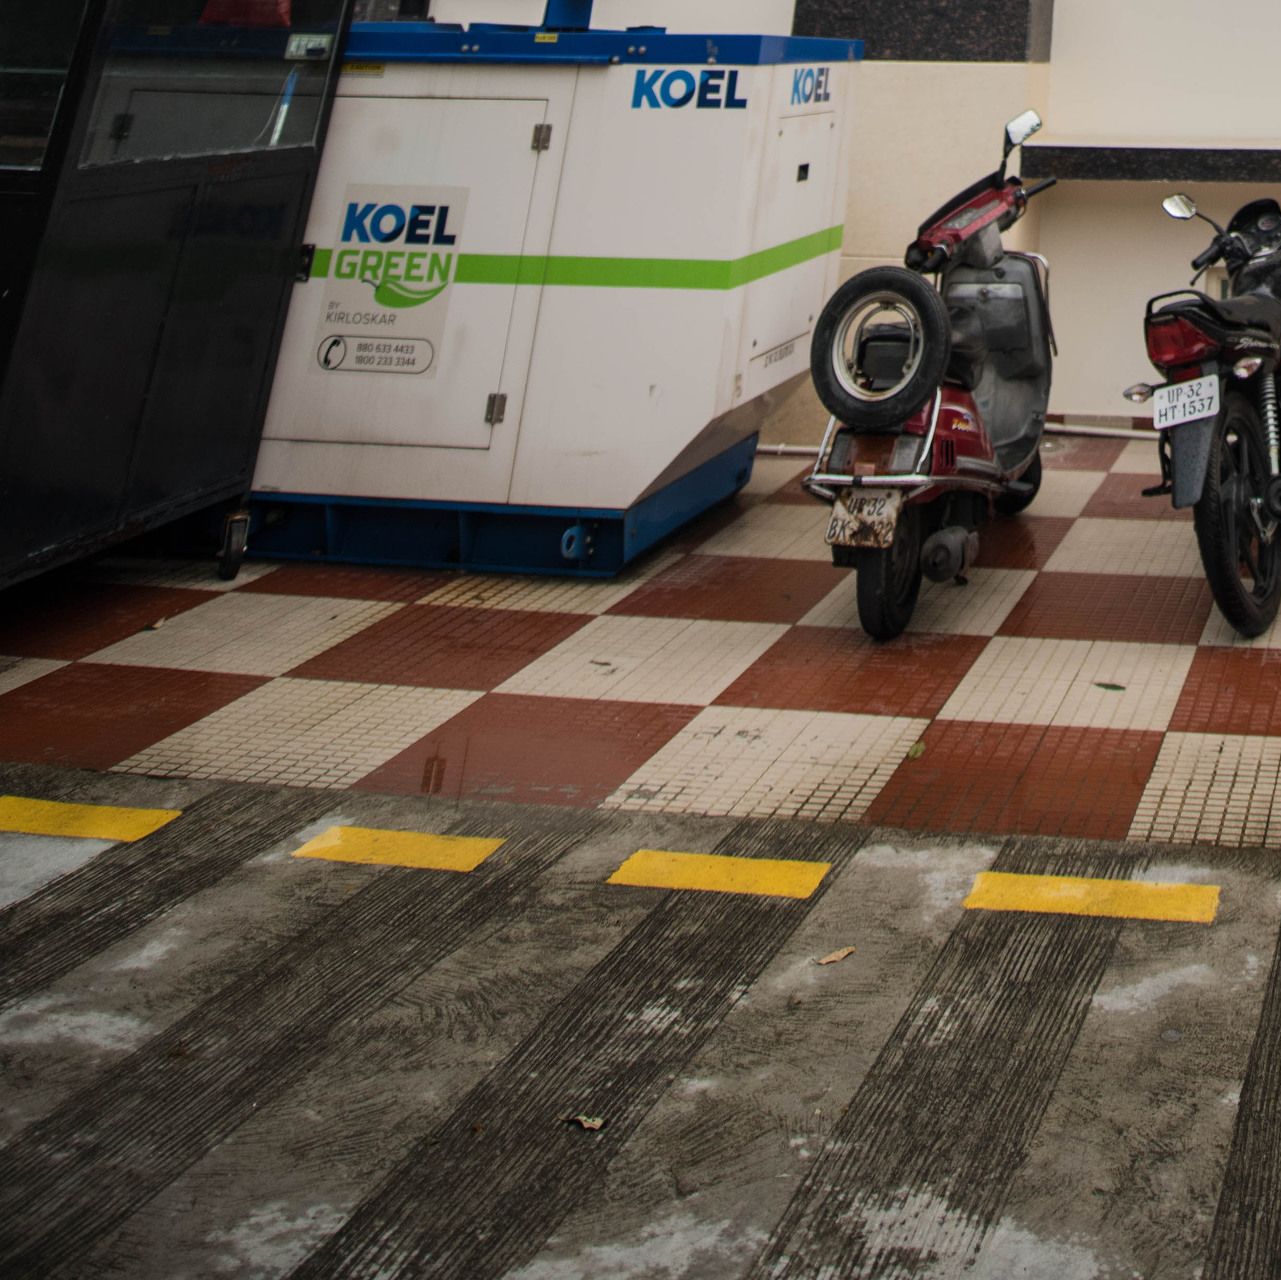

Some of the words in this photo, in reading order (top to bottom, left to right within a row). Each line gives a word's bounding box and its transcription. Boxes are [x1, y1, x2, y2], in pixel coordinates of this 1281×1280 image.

[630, 69, 748, 109] KOEL
[790, 67, 830, 106] KOEL
[340, 202, 456, 246] KOEL
[334, 248, 452, 283] GREEN
[325, 311, 397, 326] KIRLOSKAR
[327, 301, 341, 310] BY
